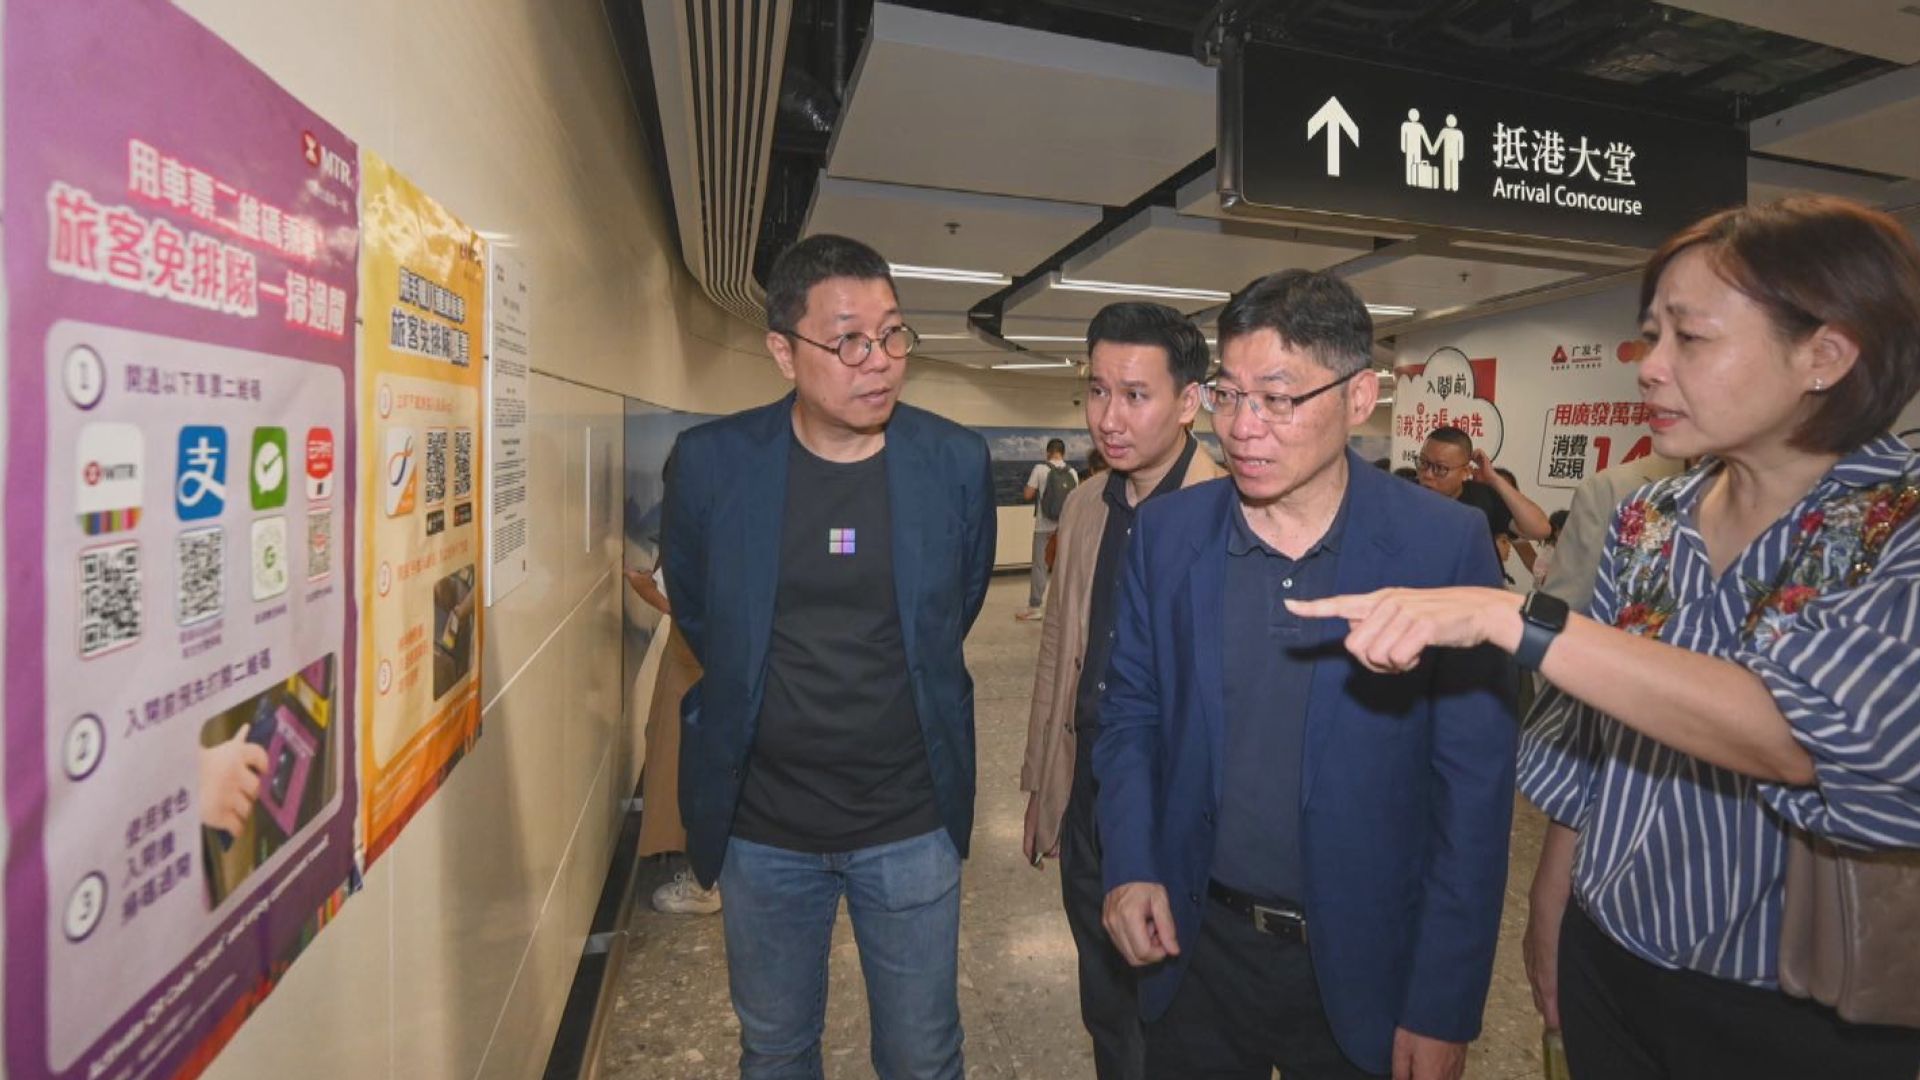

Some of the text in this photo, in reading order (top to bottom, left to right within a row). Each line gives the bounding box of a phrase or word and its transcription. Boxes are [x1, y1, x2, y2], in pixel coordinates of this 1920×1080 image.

[1493, 122, 1636, 186] 抵港大堂
[1492, 176, 1643, 215] Arrival Concourse
